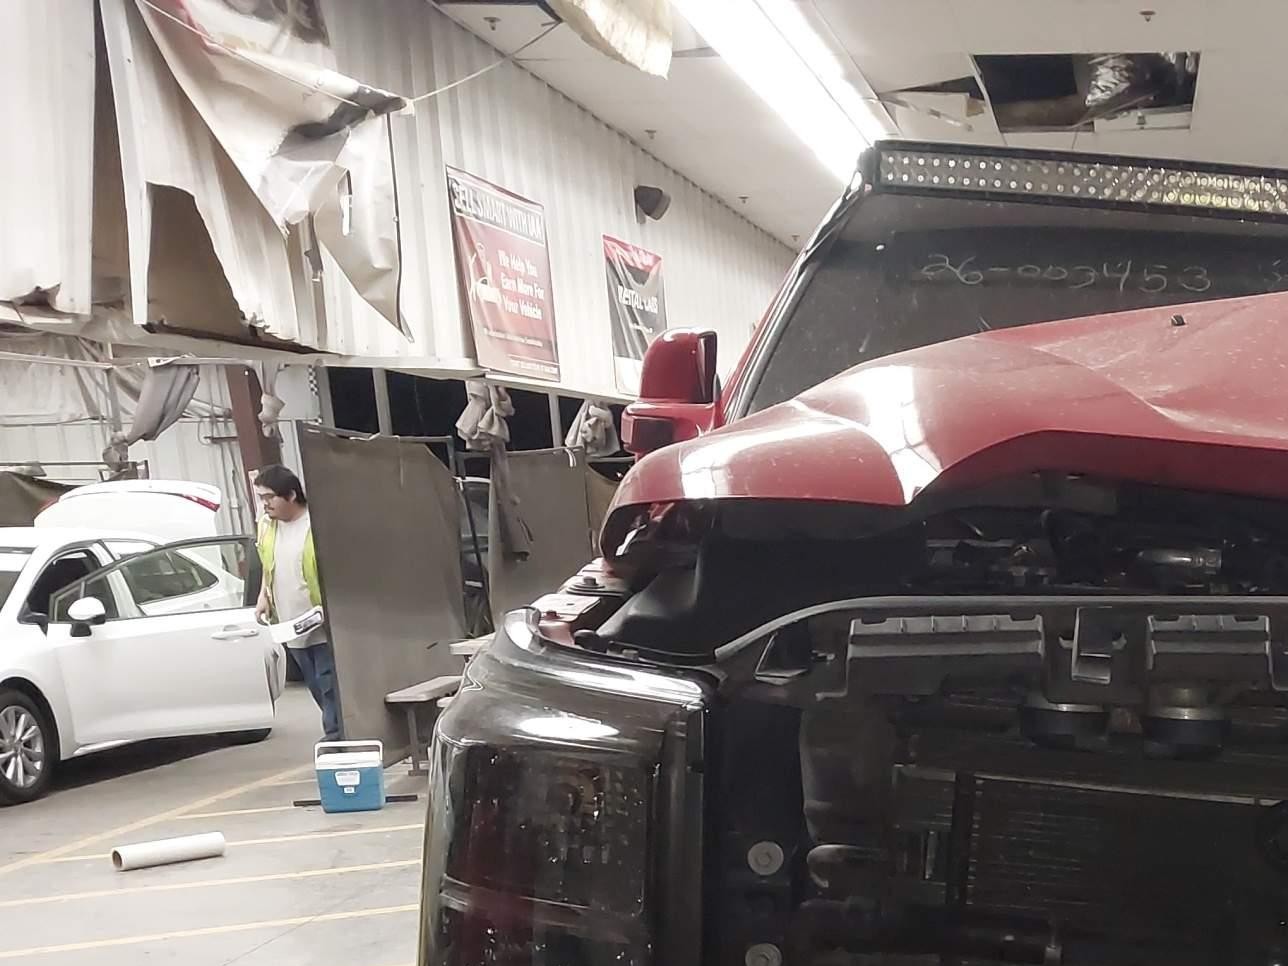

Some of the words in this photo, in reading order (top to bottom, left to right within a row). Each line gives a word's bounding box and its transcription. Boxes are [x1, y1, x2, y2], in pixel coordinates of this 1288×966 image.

[451, 181, 474, 214] SELL
[477, 192, 507, 226] SMART
[507, 207, 530, 233] WITH
[497, 249, 510, 268] We
[510, 253, 526, 273] Help
[525, 258, 538, 277] You
[500, 271, 517, 291] Earn
[517, 276, 534, 297] More
[534, 282, 545, 300] For
[503, 294, 519, 314] Your
[519, 299, 543, 320] Vehicle
